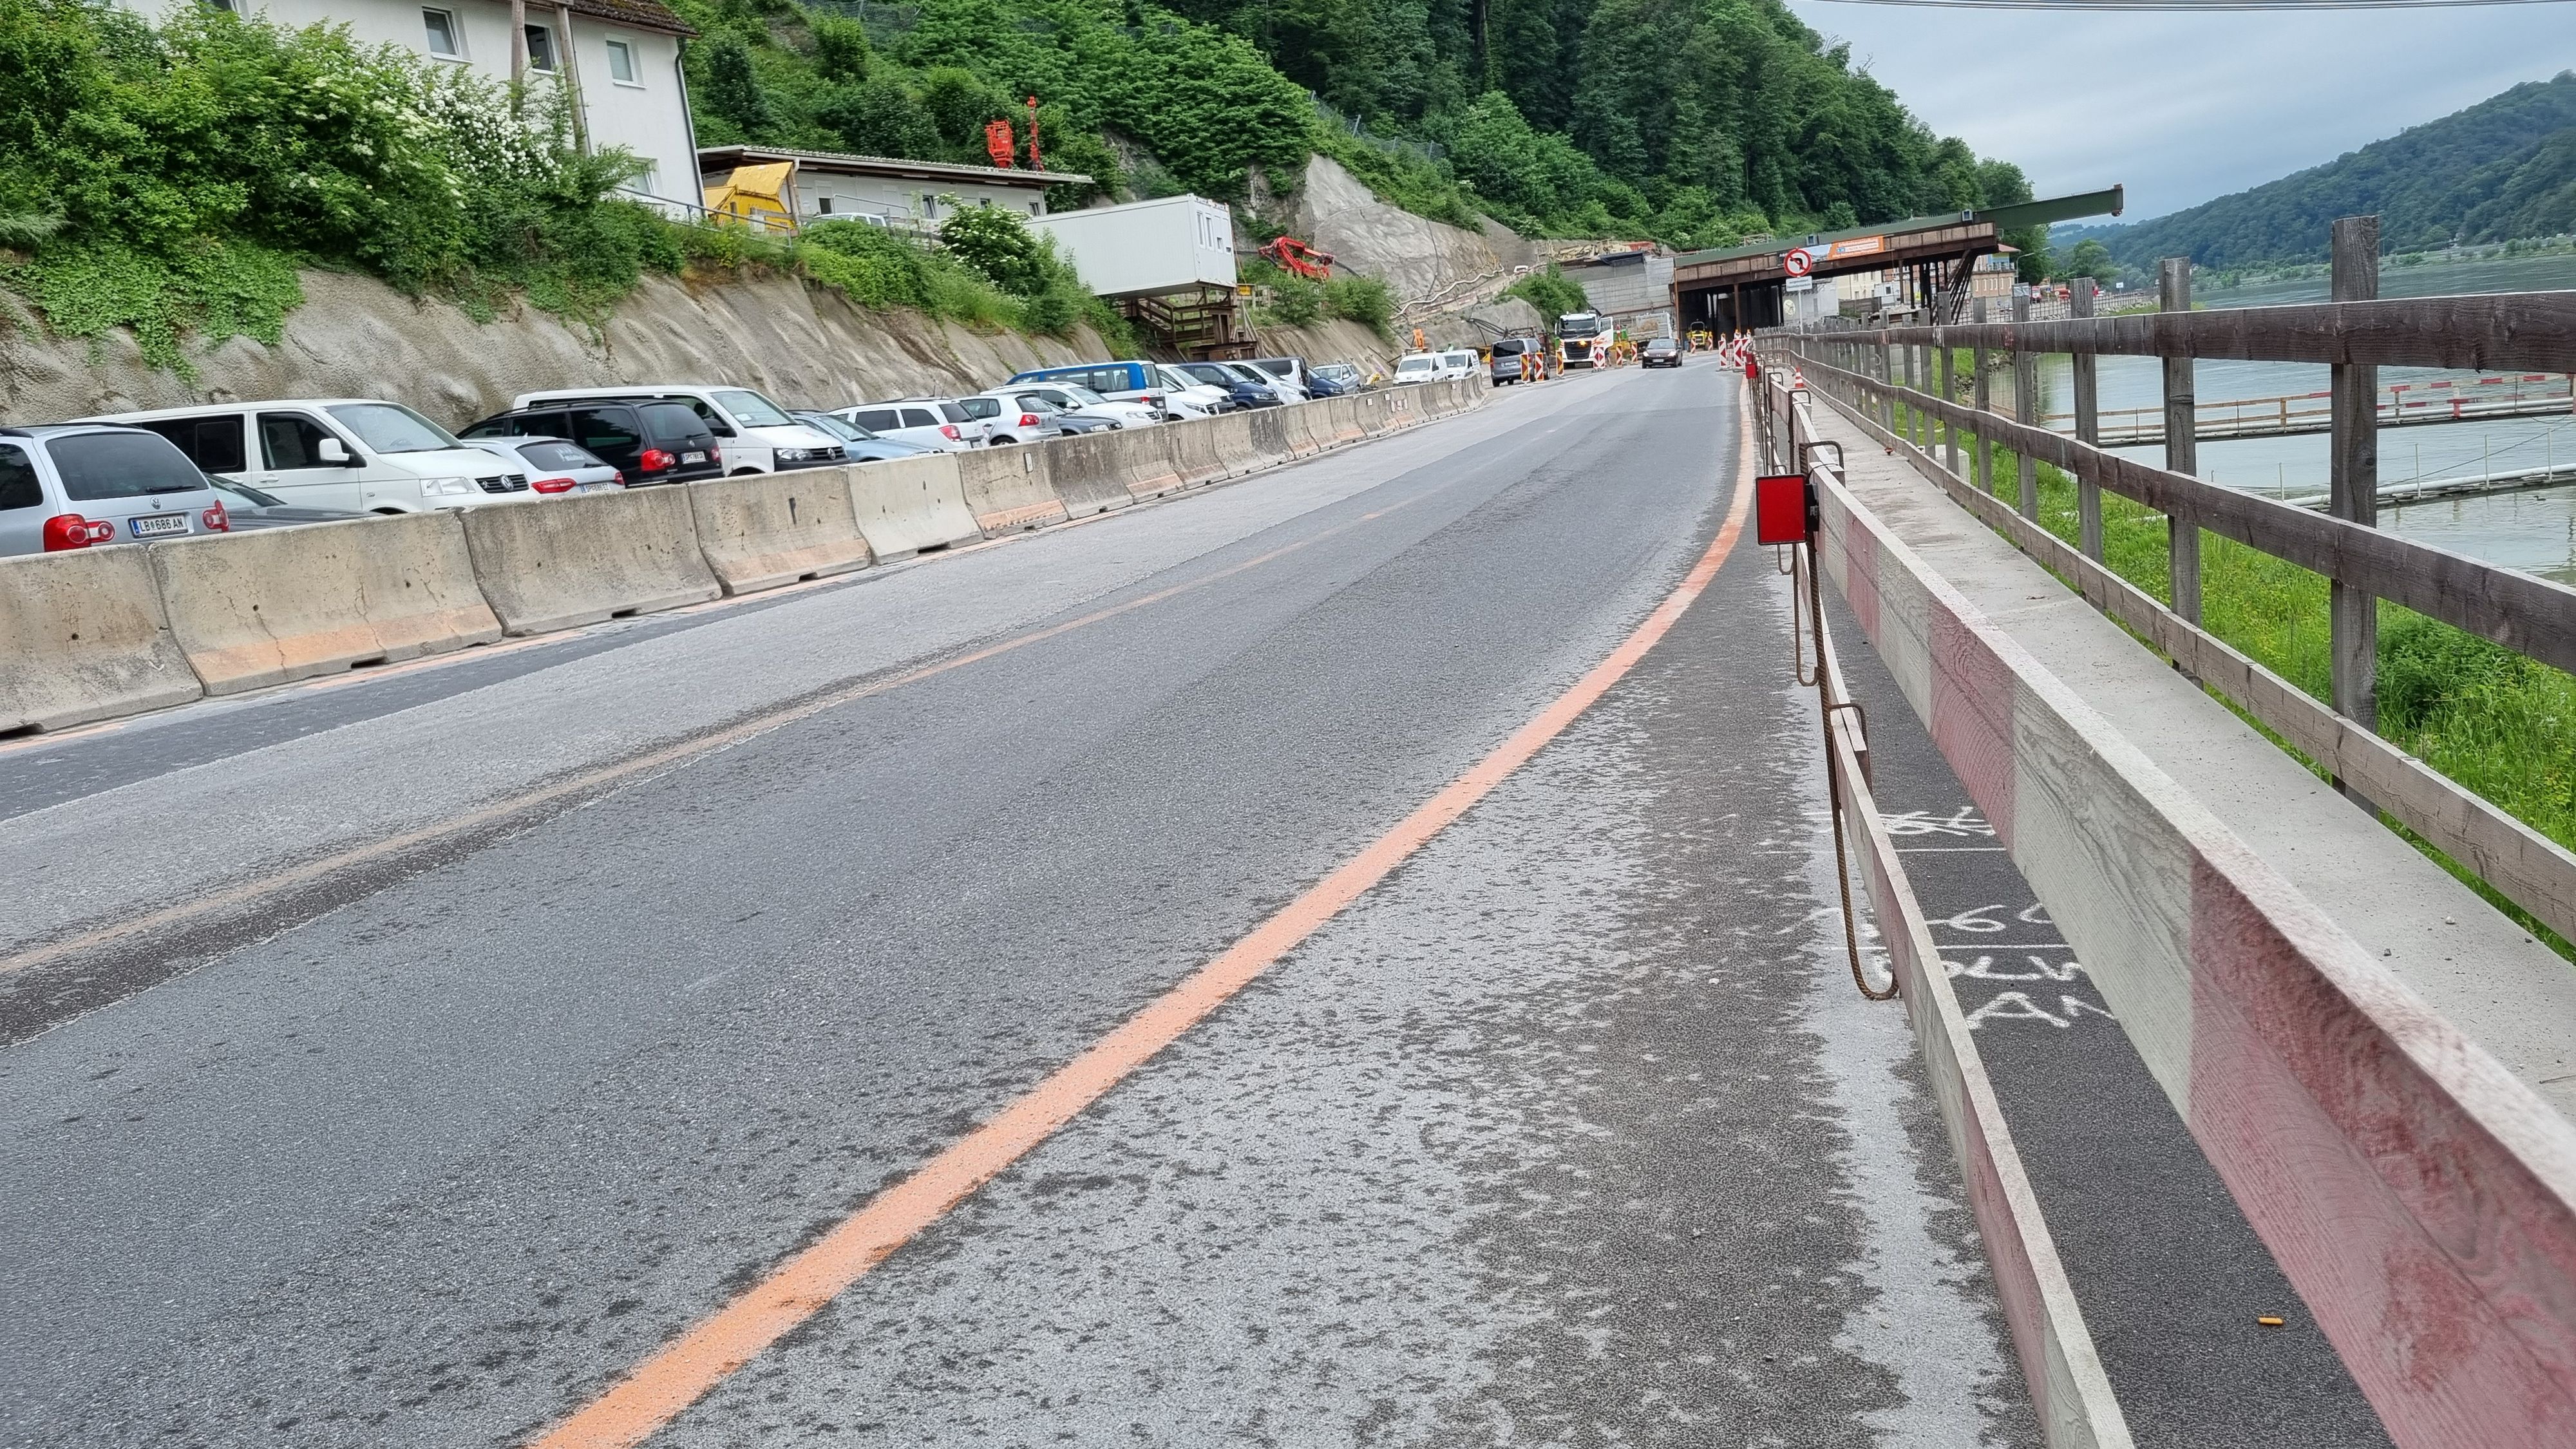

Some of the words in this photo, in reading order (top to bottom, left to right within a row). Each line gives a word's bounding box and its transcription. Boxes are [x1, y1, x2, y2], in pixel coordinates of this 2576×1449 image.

[139, 521, 151, 532] LB
[155, 519, 172, 530] 686
[173, 517, 184, 528] AN
